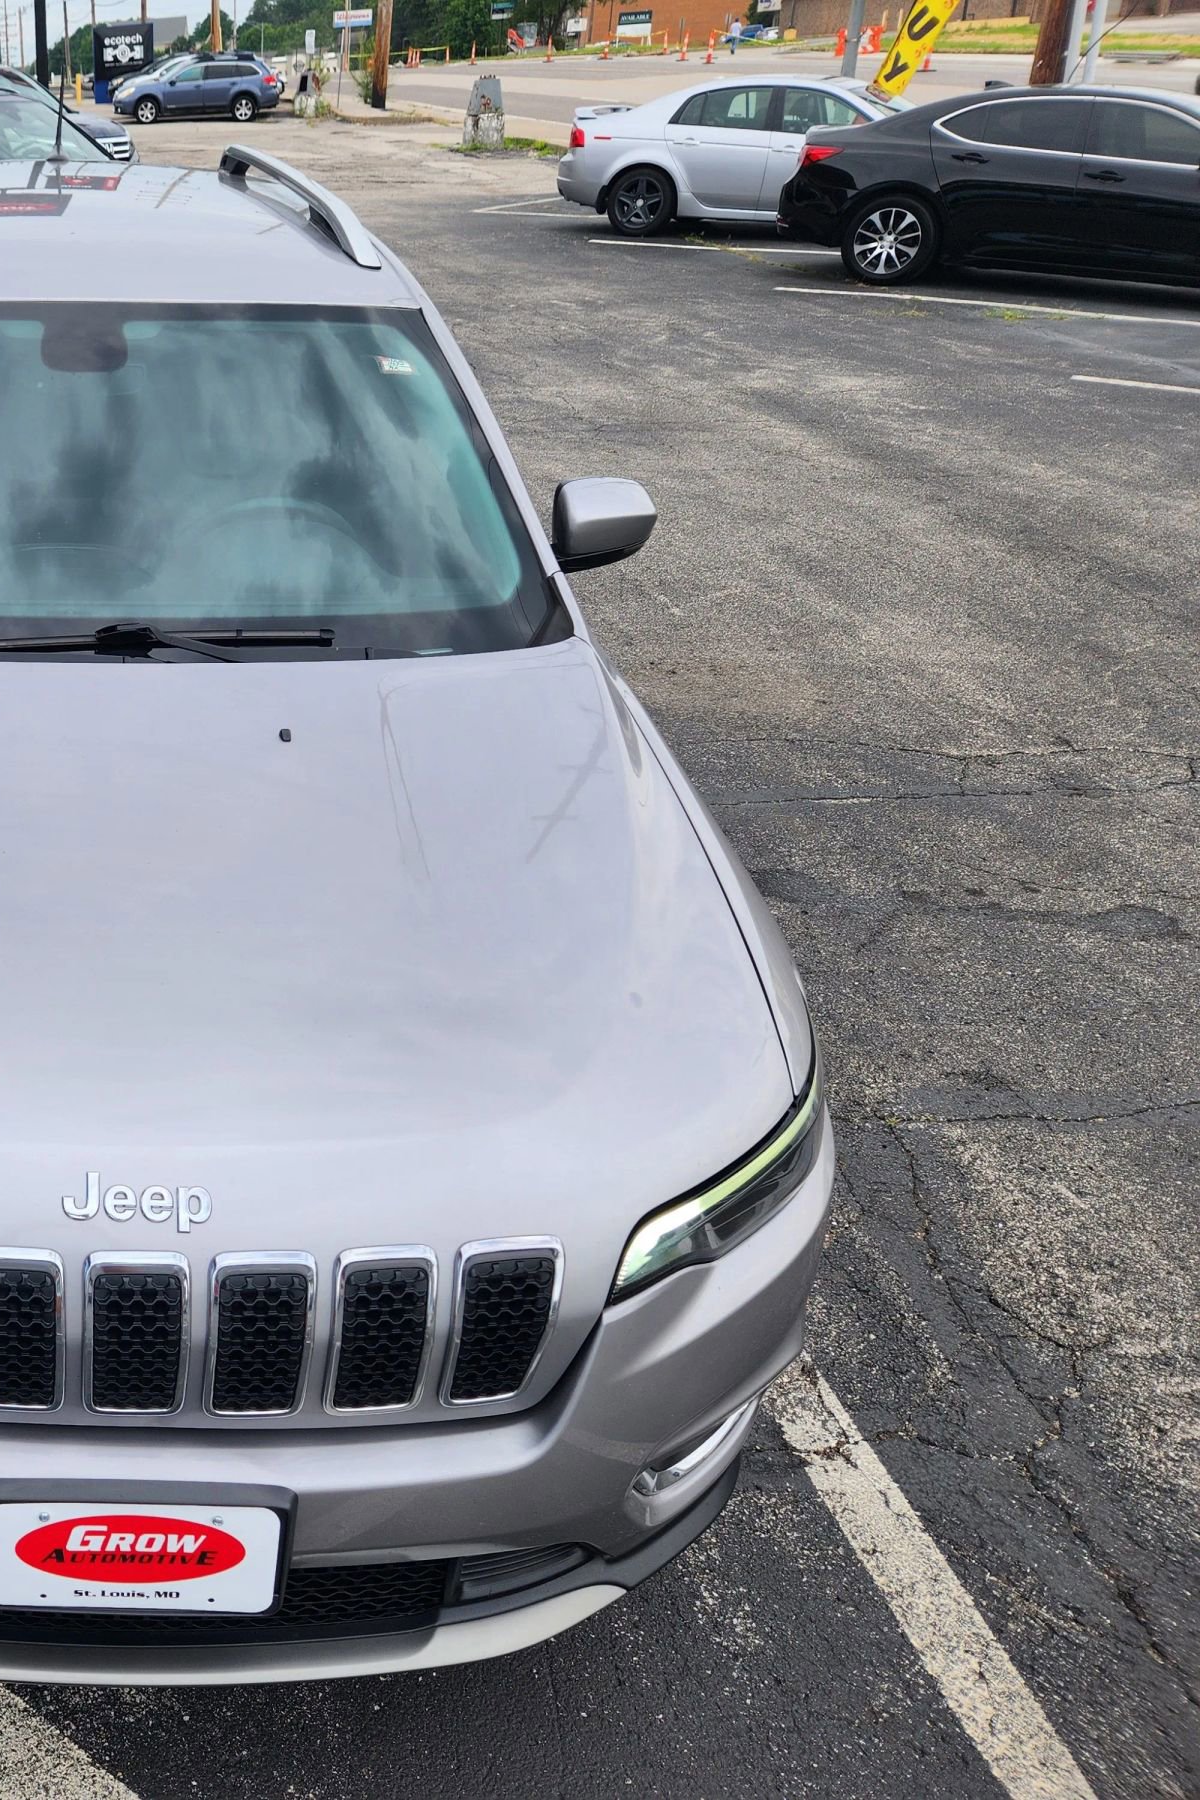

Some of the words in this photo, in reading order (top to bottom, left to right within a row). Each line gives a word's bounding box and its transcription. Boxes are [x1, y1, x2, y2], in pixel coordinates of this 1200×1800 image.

[104, 32, 143, 46] ecotech
[61, 1170, 213, 1234] Jeep
[42, 1548, 219, 1566] AUTOMOTIVE
[73, 1589, 97, 1598] St.
[100, 1590, 150, 1599] Louis,
[154, 1590, 181, 1599] MO
